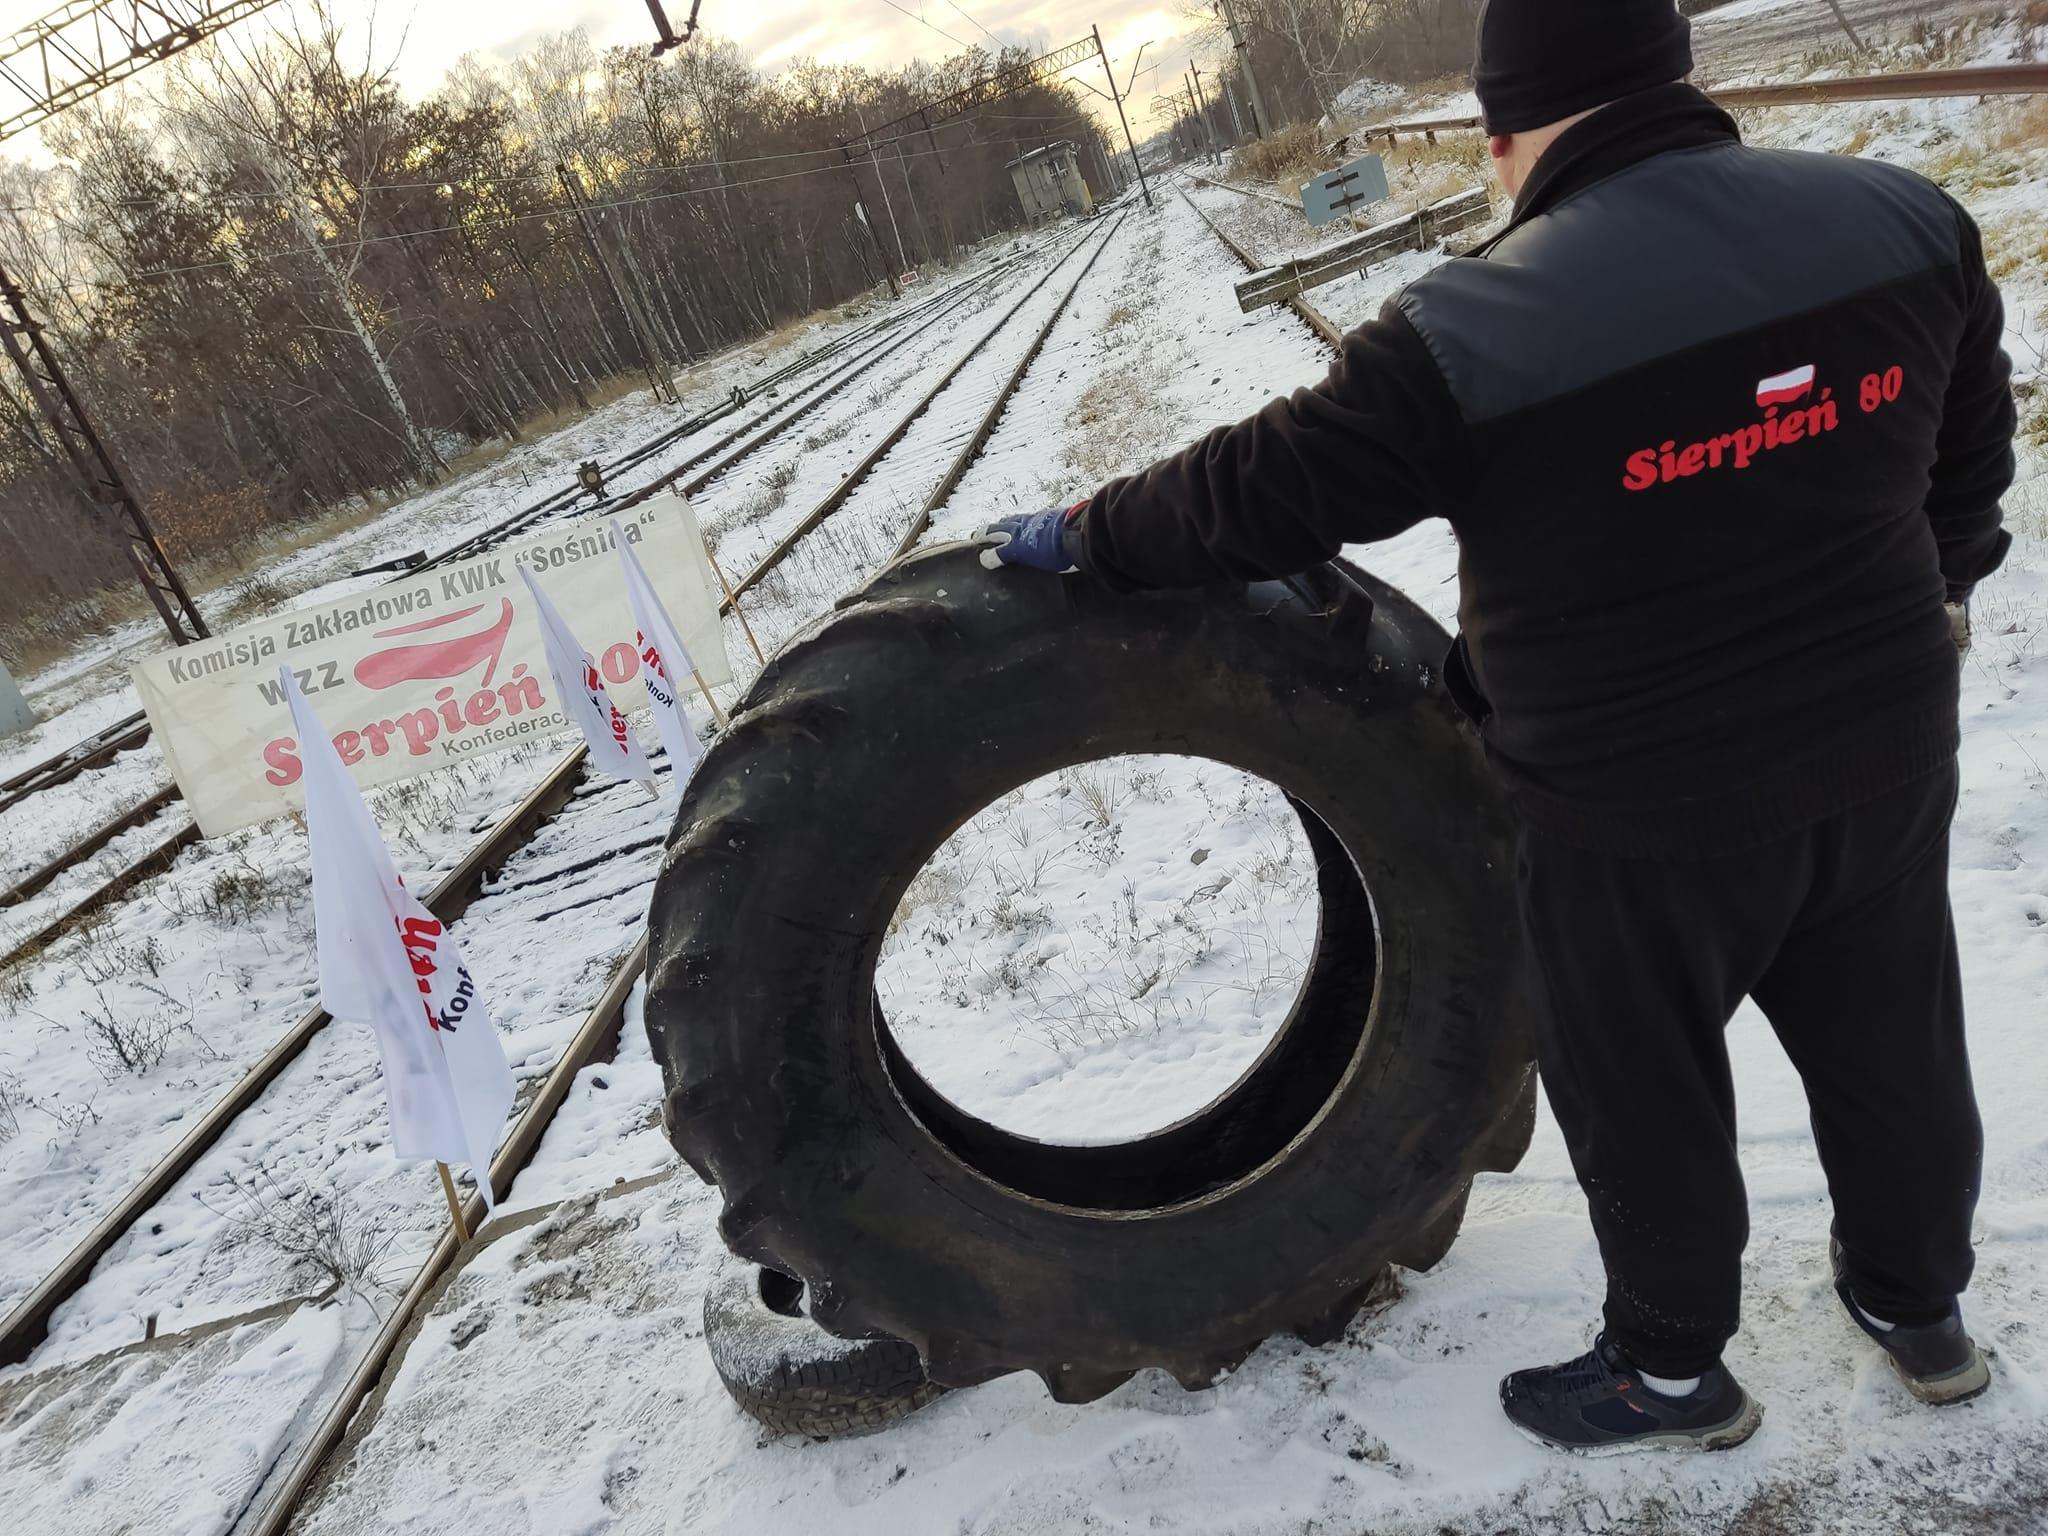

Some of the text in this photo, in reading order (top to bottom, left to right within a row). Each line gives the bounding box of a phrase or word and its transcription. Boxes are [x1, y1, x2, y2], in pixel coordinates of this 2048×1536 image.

[1622, 366, 1904, 491] Sierpień 80
[167, 634, 276, 685] Komisja
[283, 586, 433, 649] Zakładowa
[440, 558, 506, 601] KWK
[263, 663, 546, 787] Serpień
